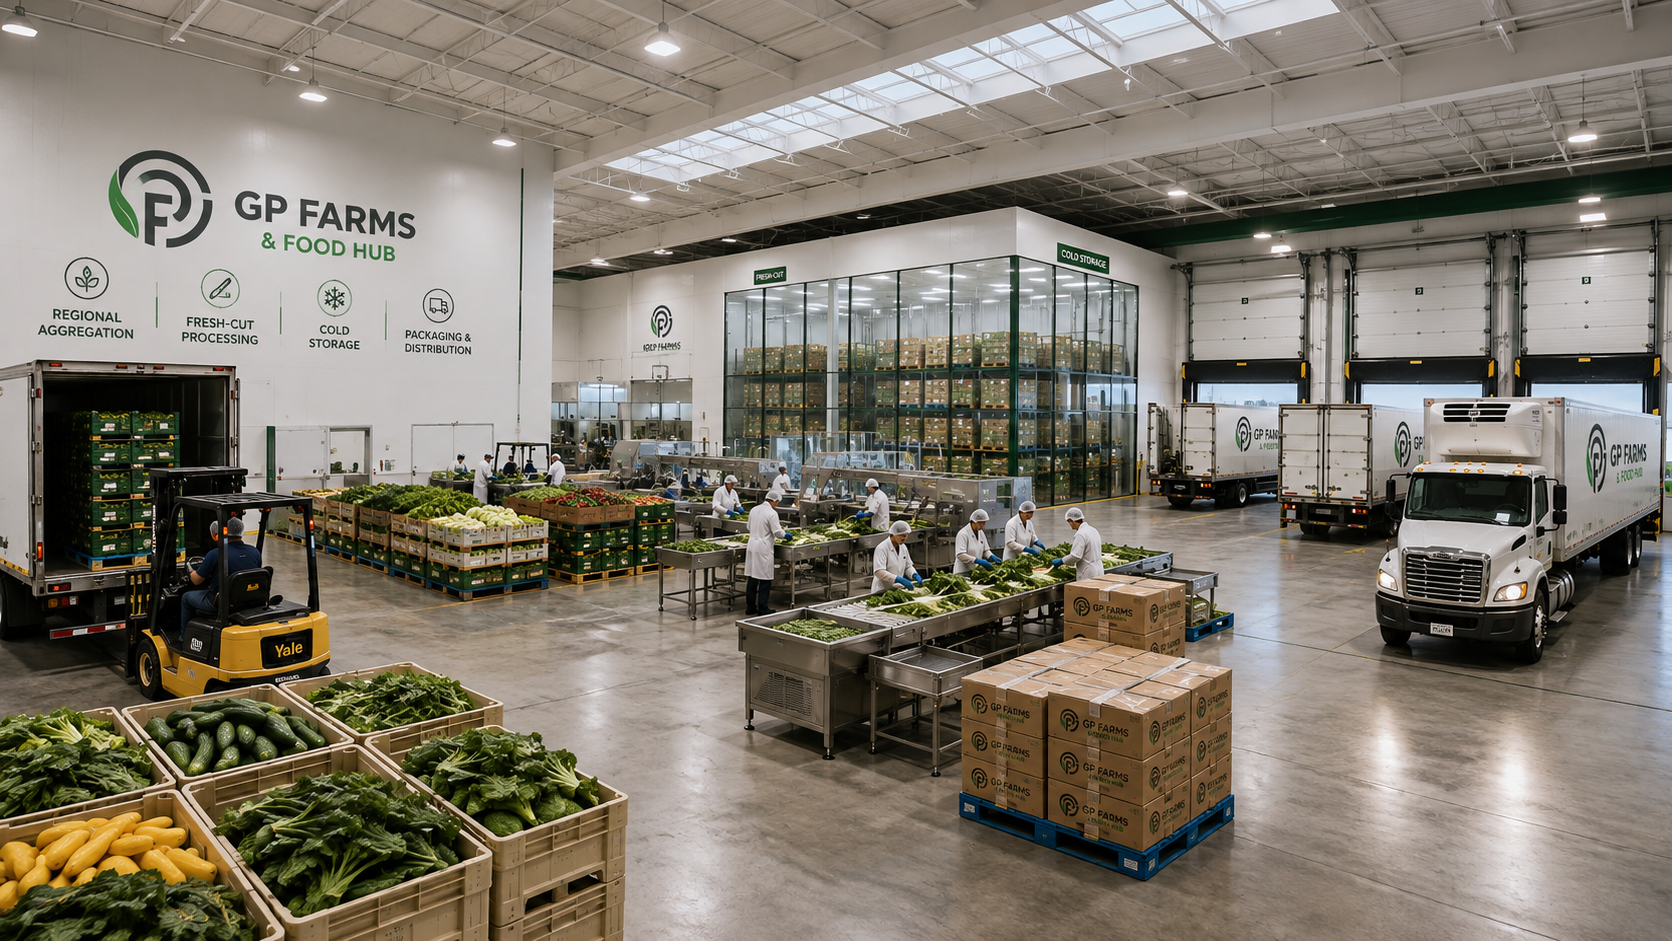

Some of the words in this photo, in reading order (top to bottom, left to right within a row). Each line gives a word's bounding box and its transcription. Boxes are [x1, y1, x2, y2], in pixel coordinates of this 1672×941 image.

[234, 190, 288, 223] GP
[299, 198, 416, 240] FARMS
[260, 231, 276, 250] &
[283, 233, 346, 257] FOOD
[353, 242, 396, 263] HUB
[1061, 249, 1079, 261] COLD
[52, 308, 122, 323] REGIONAL
[186, 316, 254, 330] FRESH-CUT
[38, 324, 134, 340] AGGREGATION
[319, 324, 350, 336] COLD
[405, 329, 462, 342] PACKAGING
[464, 333, 472, 342] &
[181, 331, 259, 346] PROCESSING
[309, 338, 360, 350] STORAGE
[405, 343, 472, 355] DISTRIBUTION
[1254, 428, 1264, 440] GP
[1413, 436, 1424, 450] GP
[1610, 444, 1622, 467] GP
[1624, 443, 1647, 465] FARMS
[1093, 603, 1104, 612] GP
[1106, 605, 1133, 618] FARMS
[275, 641, 303, 658] Yale
[990, 702, 1002, 712] GP
[1082, 719, 1096, 730] GP
[1098, 722, 1129, 738] FARMS
[1082, 762, 1096, 773] GP
[1097, 766, 1129, 783] FARMS
[1082, 805, 1096, 815] GP
[1097, 810, 1129, 827] FARMS
